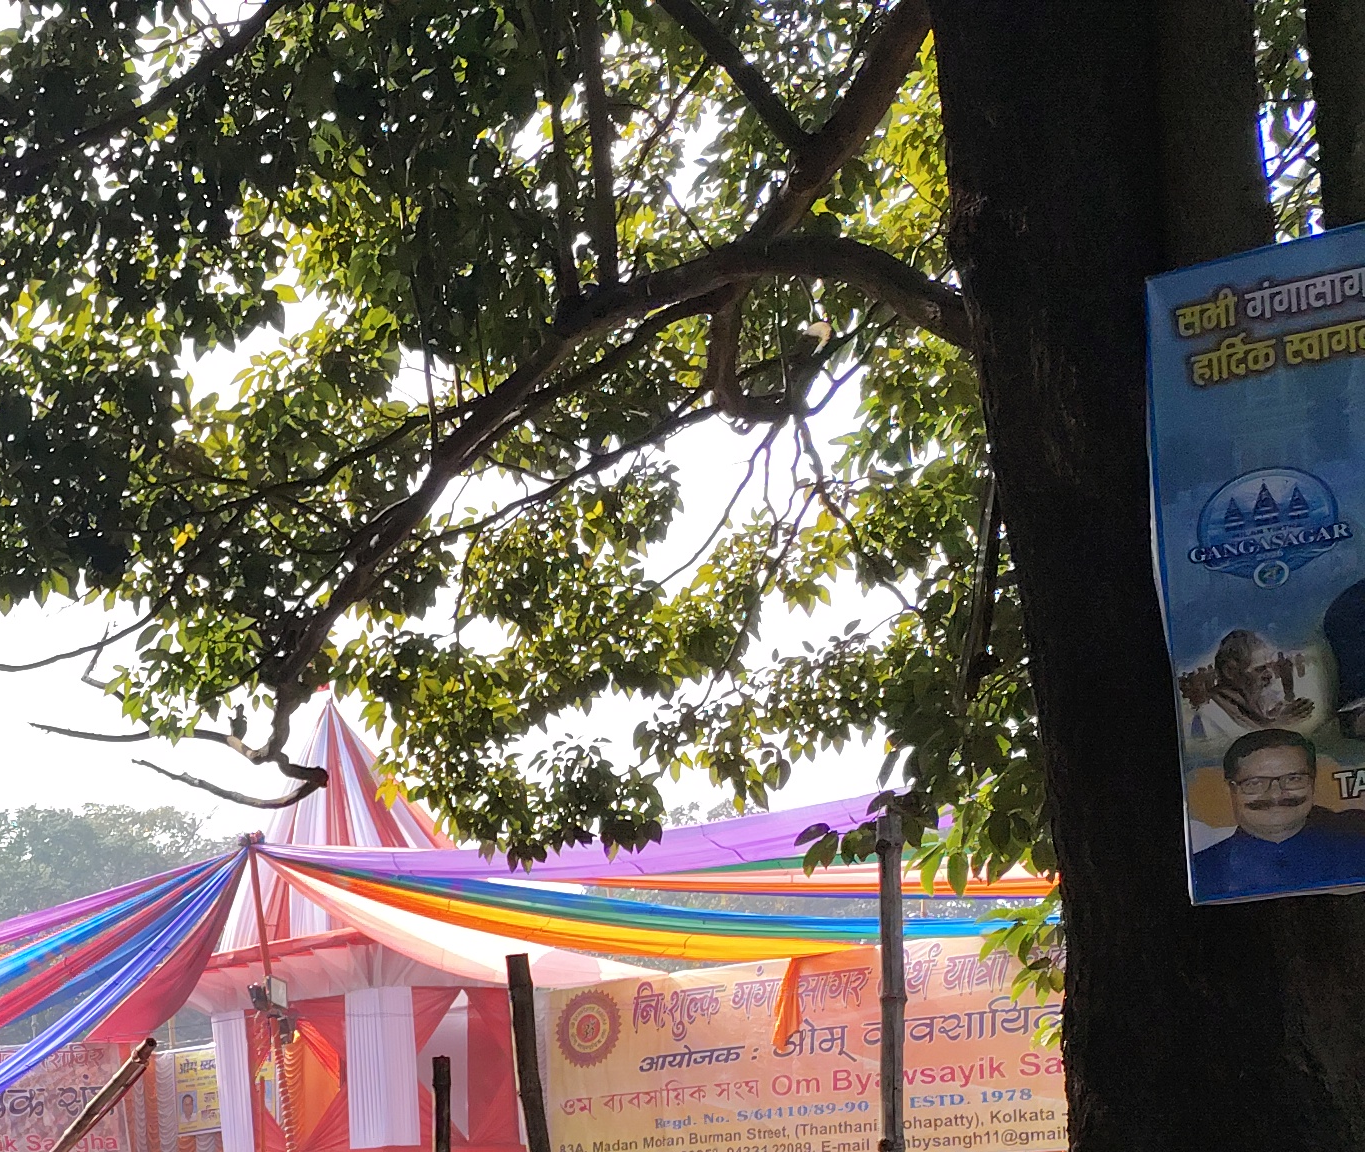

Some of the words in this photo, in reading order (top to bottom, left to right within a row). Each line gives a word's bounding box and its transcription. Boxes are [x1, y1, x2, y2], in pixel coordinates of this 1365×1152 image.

[1175, 288, 1238, 337] सभी
[1244, 267, 1365, 319] गंगासाग
[1191, 332, 1276, 385] हार्दिक
[1188, 521, 1354, 564] GANGASAGAR
[639, 1045, 746, 1073] आयोजक
[714, 1077, 760, 1102] সংঘ
[771, 1074, 820, 1097] Om
[703, 1112, 730, 1125] No.
[980, 1088, 1033, 1104] 1978
[689, 1130, 742, 1145] Burman
[795, 1118, 880, 1139] (Thanthani
[903, 1112, 984, 1132] ohapatty),
[990, 1108, 1055, 1124] Kolkata
